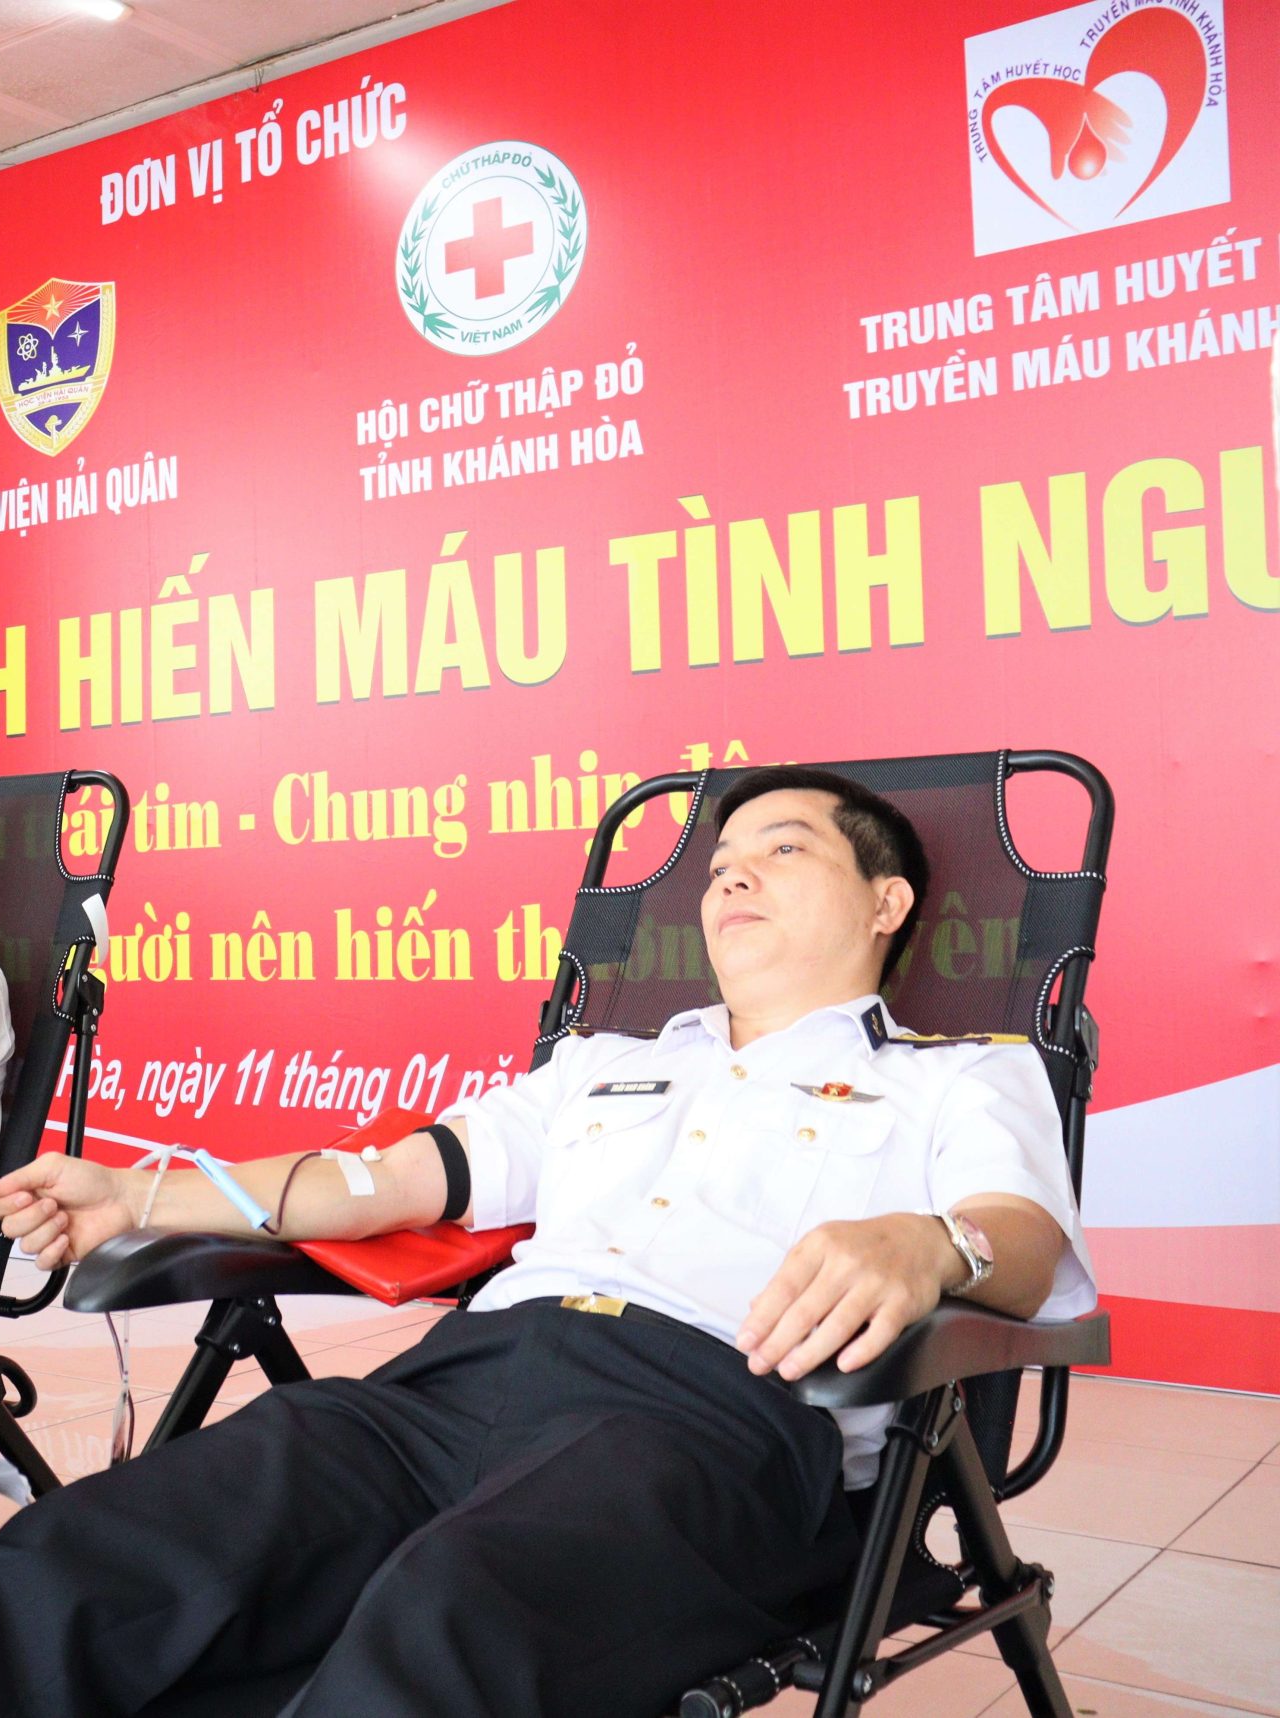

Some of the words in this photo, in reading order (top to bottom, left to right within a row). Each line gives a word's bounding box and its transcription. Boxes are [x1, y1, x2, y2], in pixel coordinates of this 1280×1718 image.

[1170, 0, 1200, 16] NH
[100, 155, 176, 225] ĐƠN
[187, 138, 223, 204] VỊ
[235, 98, 284, 183] TỔ
[296, 75, 406, 166] CHỨC
[968, 108, 987, 163] TRUNG
[1005, 58, 1050, 78] HUYẾT
[1053, 64, 1081, 81] HỌC
[461, 329, 490, 345] VIỆT
[492, 319, 522, 340] NAM
[860, 293, 993, 354] TRUNG
[1006, 270, 1099, 325] TÂM
[1114, 226, 1262, 305] HUYẾT
[356, 399, 408, 448] HỘI
[420, 380, 488, 434] CHỮ
[495, 366, 583, 419] THẬP
[594, 342, 644, 400] ĐỎ
[842, 348, 998, 420] TRUYỀN
[1011, 334, 1110, 391] MÁU
[1125, 304, 1280, 371] KHÁNH
[56, 457, 97, 520] HẢI
[106, 451, 178, 515] QUÂN
[359, 451, 432, 501] TỈNH
[443, 436, 558, 487] KHÁNH
[571, 415, 644, 466] HÒA
[59, 553, 275, 732] HIẾN
[315, 530, 567, 706] MÁU
[608, 495, 925, 676] TÌNH
[132, 782, 221, 855] tim
[239, 814, 255, 830] -
[272, 770, 468, 859] Chung
[66, 902, 193, 992] ười
[210, 910, 317, 982] nên
[334, 889, 475, 982] hiến
[137, 1047, 226, 1119] ngày
[234, 1048, 276, 1106] 11
[279, 1049, 392, 1126] tháng
[397, 1053, 450, 1114] 01
